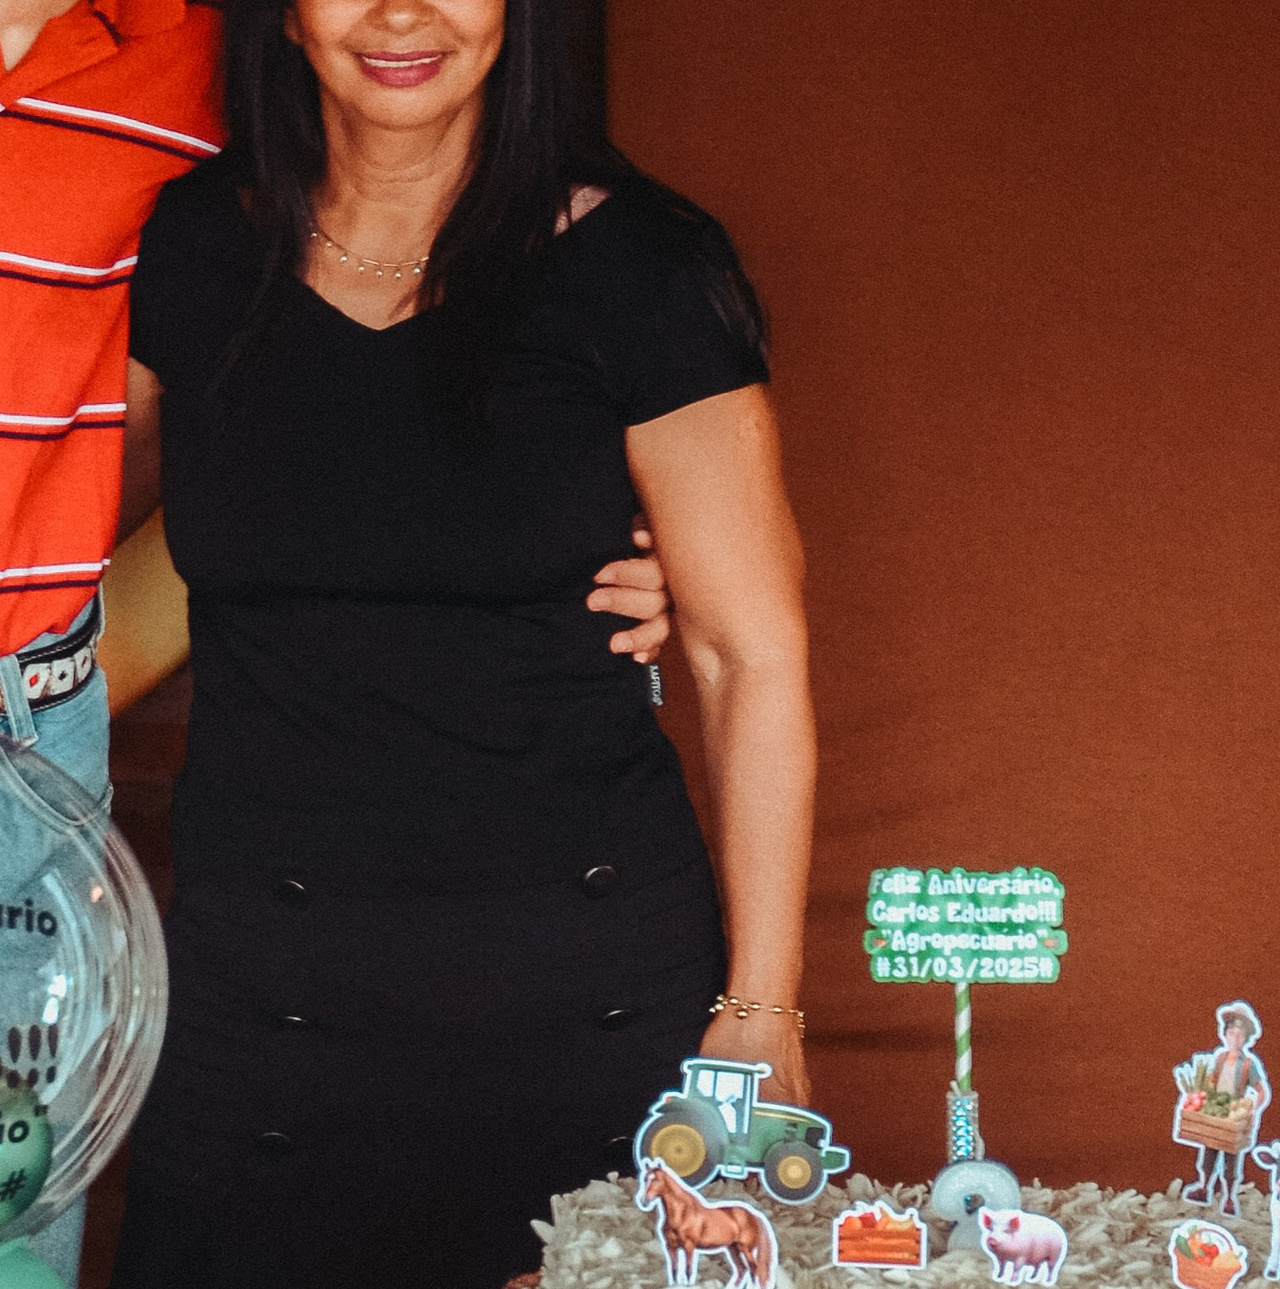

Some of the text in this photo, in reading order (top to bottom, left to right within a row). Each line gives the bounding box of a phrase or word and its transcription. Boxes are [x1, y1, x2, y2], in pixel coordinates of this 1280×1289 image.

[871, 873, 921, 895] Feliz
[872, 900, 1057, 924] Carlos Eduardo!!!
[876, 956, 1054, 979] #31/03/2025#
